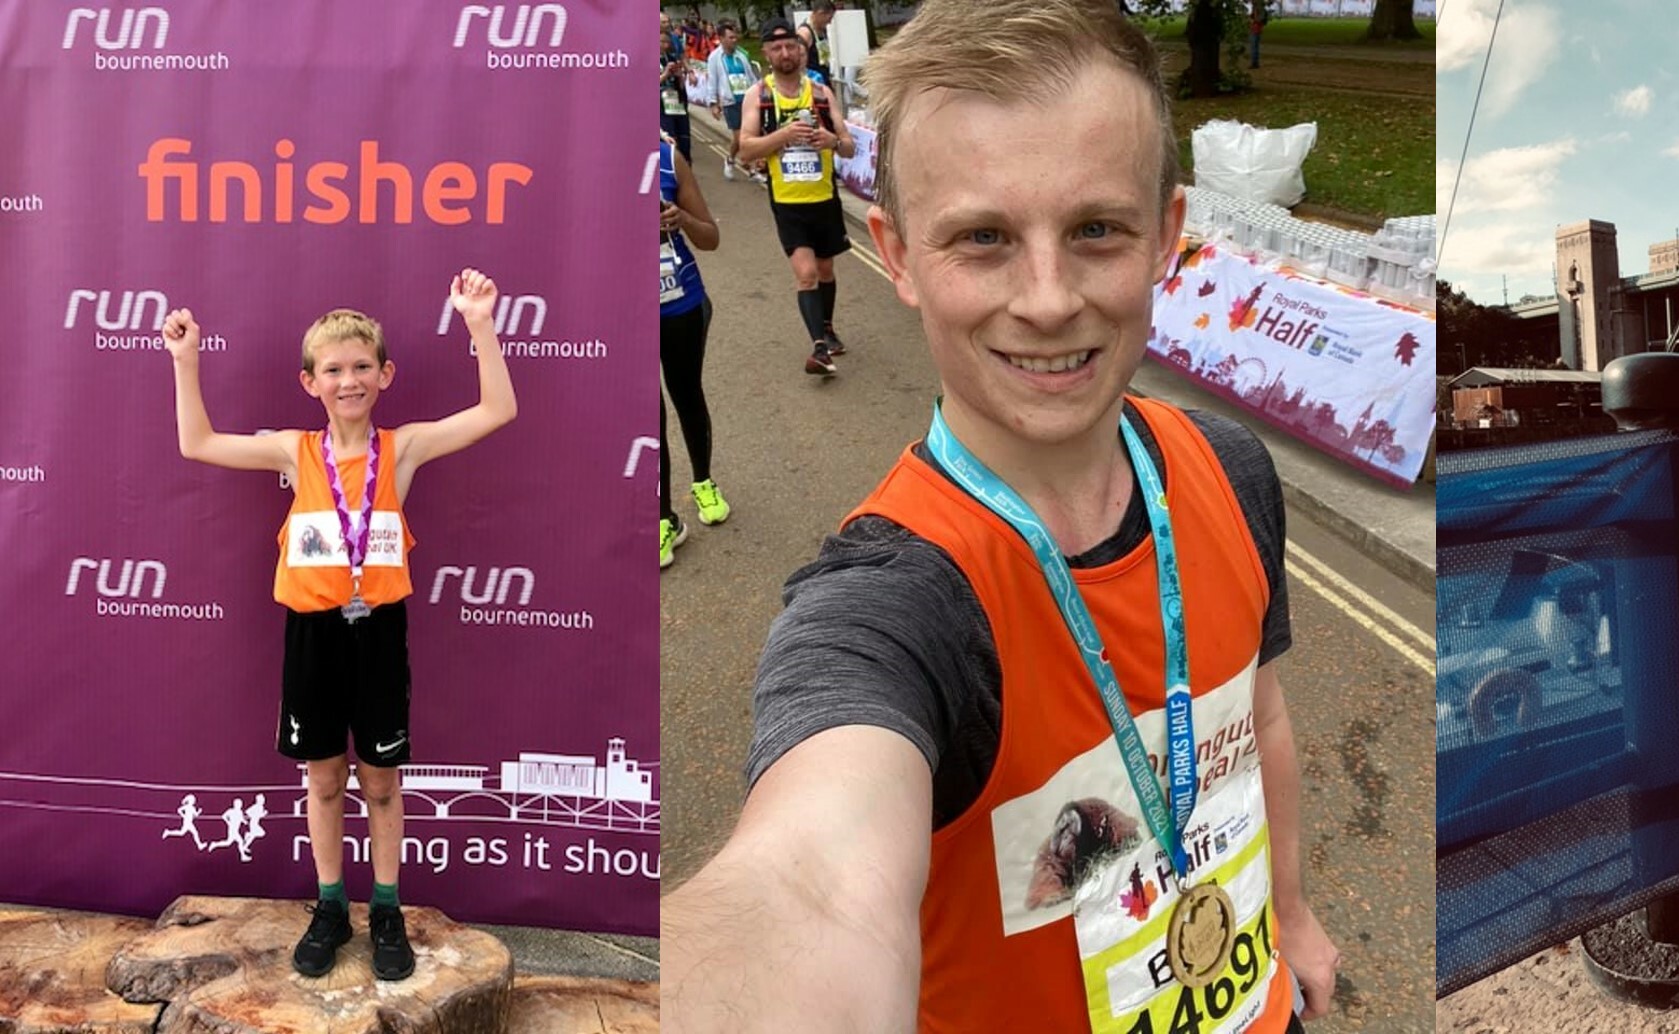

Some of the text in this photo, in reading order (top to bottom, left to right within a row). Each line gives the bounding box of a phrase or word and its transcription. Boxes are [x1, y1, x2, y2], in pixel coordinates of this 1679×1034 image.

[62, 8, 169, 49] run
[453, 4, 567, 47] run
[95, 51, 229, 70] bournemouth
[487, 50, 629, 68] bournemouth
[138, 138, 533, 224] finisher
[786, 162, 816, 173] 9466
[64, 289, 168, 330] run
[1272, 292, 1328, 320] Royal Parks
[1254, 306, 1319, 350] Half
[65, 557, 167, 598] run
[429, 566, 535, 605] run
[97, 599, 223, 619] bournemouth
[460, 606, 593, 629] bournemouth
[1103, 681, 1132, 734] SUNDAY
[1170, 699, 1189, 733] HALF
[1122, 730, 1137, 750] 10
[1127, 749, 1159, 804] OCTOBER
[1172, 738, 1192, 787] PARKS
[463, 836, 509, 865] as
[523, 833, 551, 870] it
